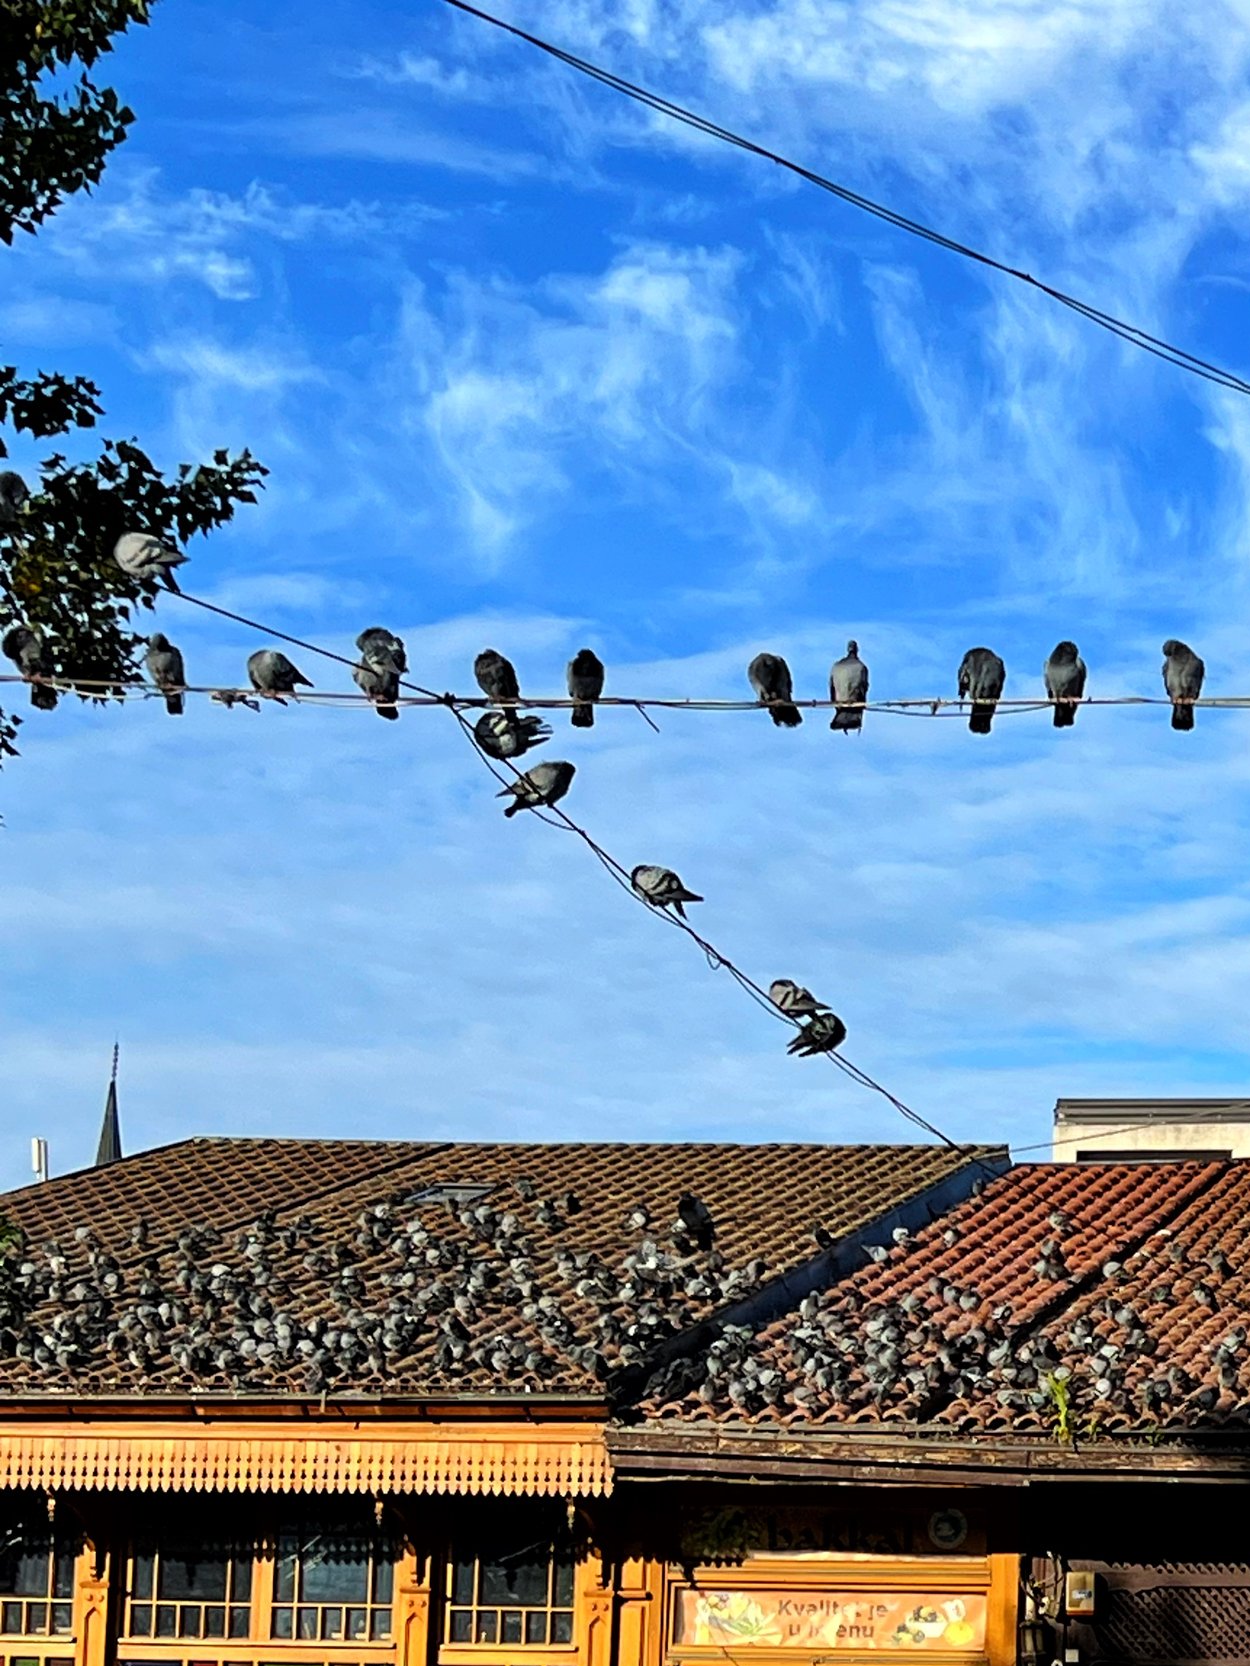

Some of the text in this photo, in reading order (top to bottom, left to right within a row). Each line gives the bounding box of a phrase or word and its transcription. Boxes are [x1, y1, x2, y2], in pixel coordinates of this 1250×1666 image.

[777, 1599, 862, 1619] Kvalit
[789, 1622, 875, 1640] u ienu
